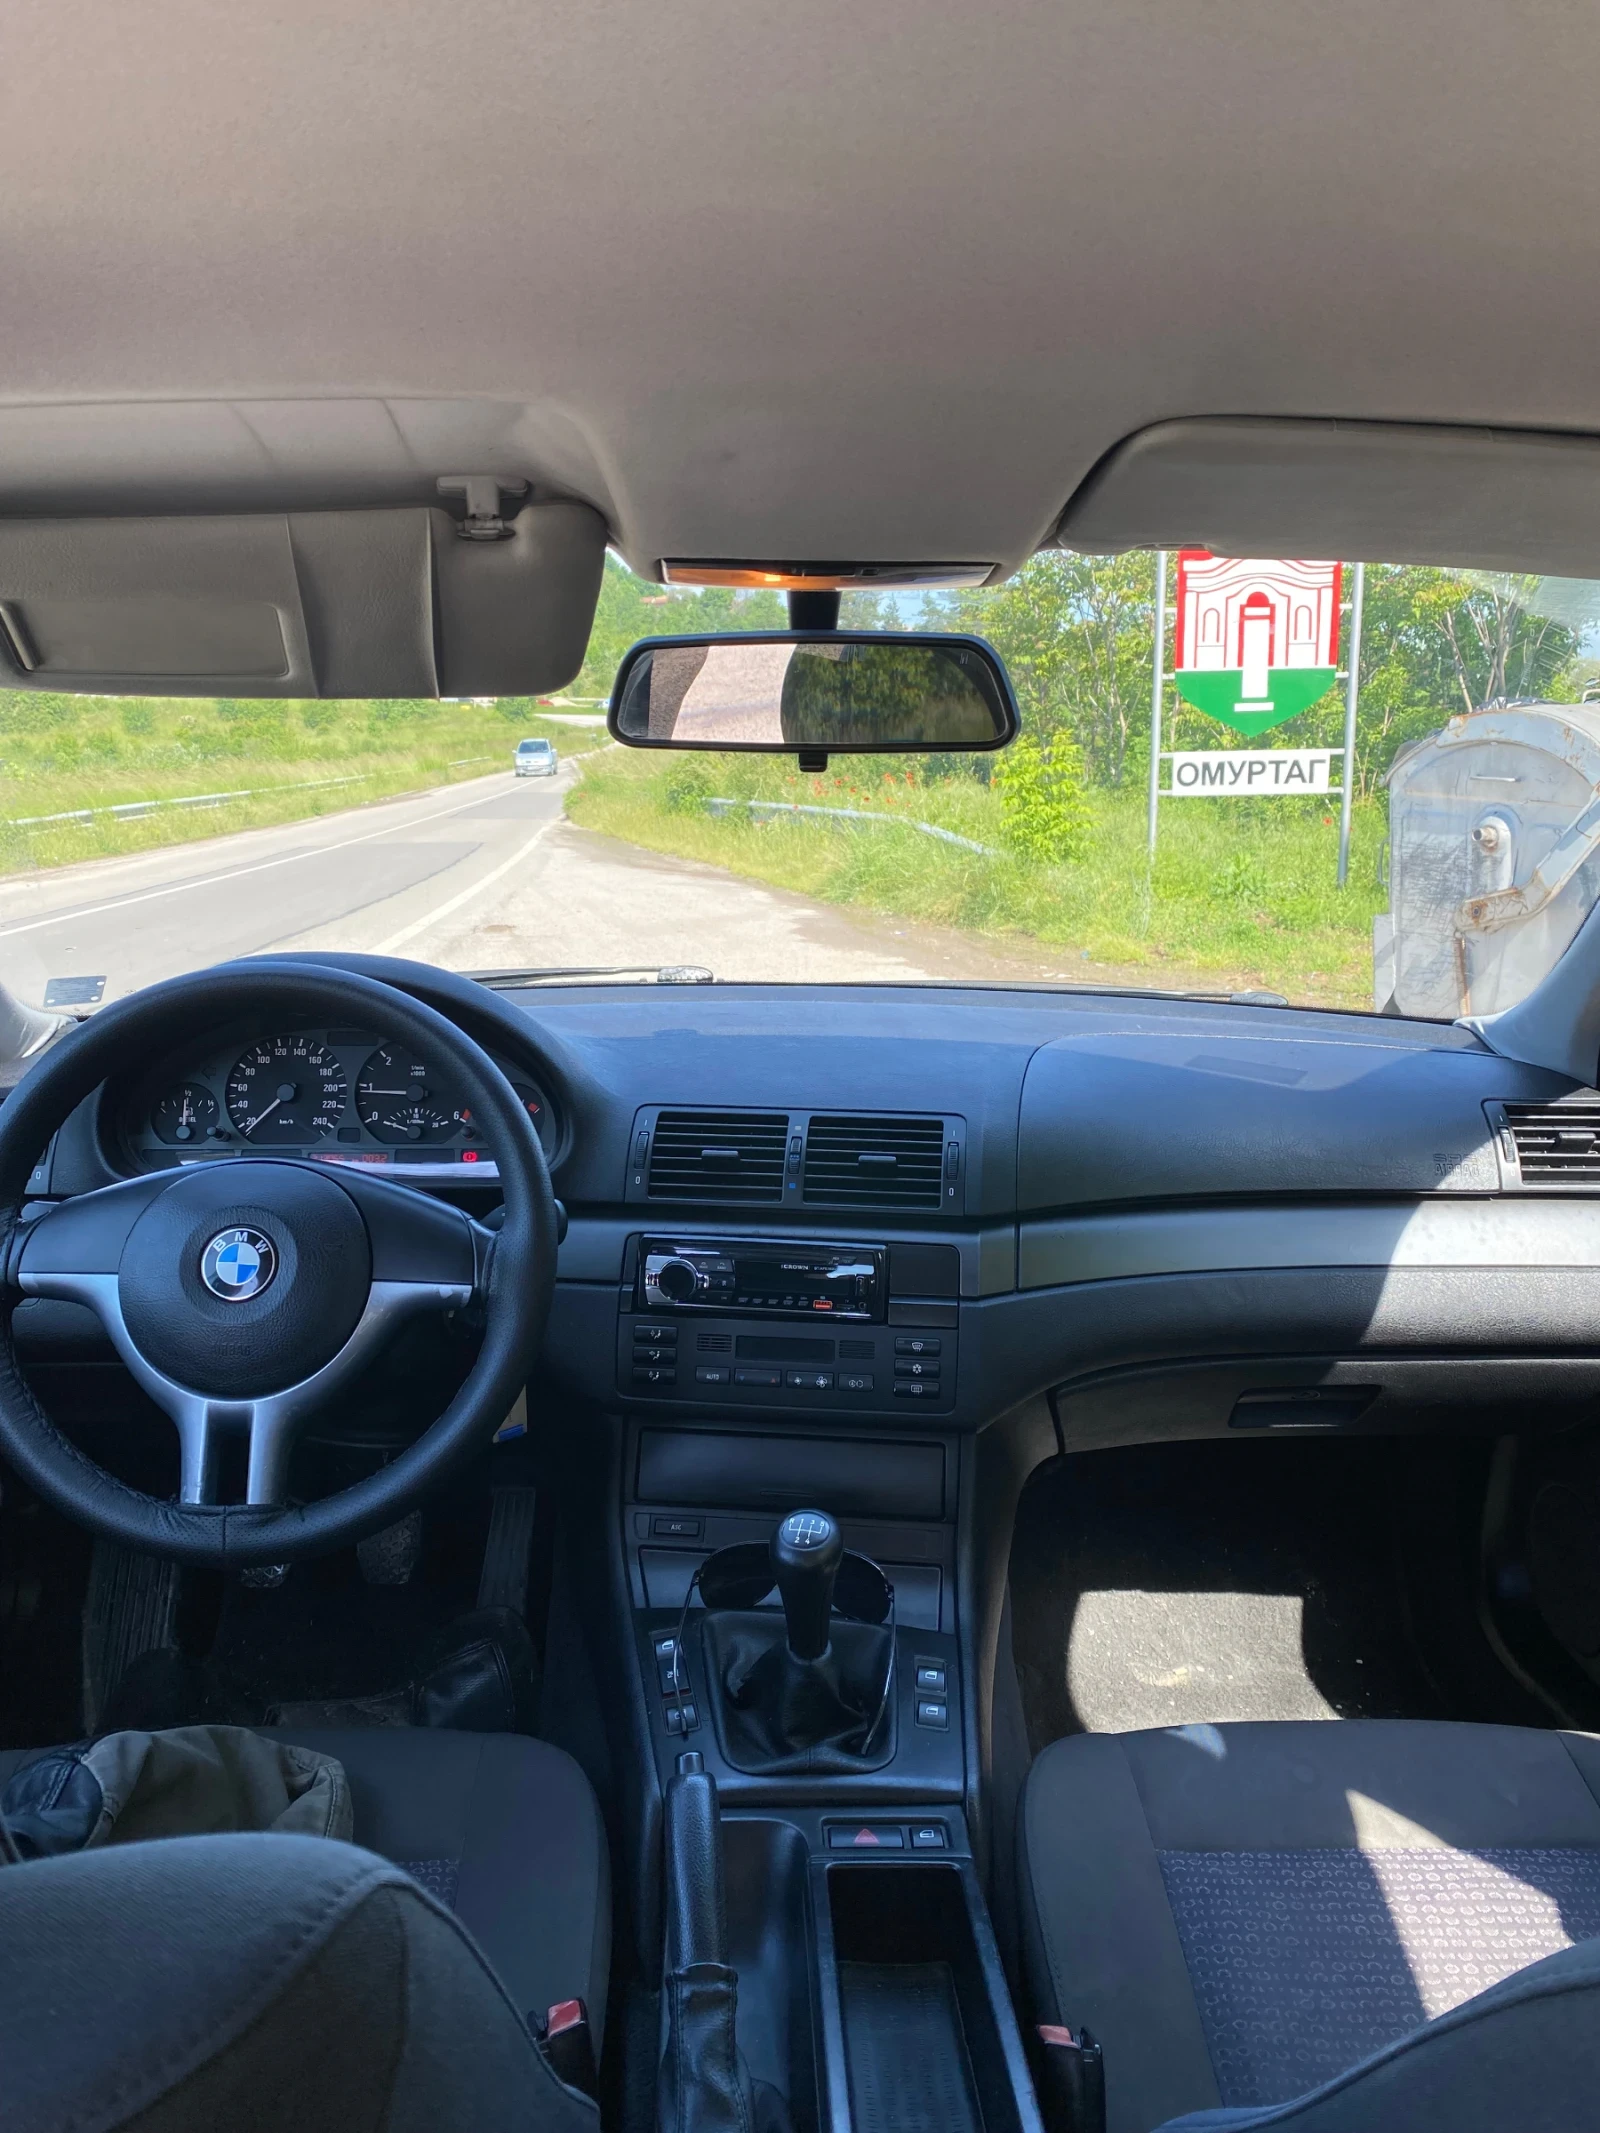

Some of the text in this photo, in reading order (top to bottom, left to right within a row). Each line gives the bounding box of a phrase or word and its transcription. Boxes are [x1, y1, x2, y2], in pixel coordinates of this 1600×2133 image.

[1176, 759, 1327, 787] ОМУРТАГ
[274, 1048, 287, 1056] 120
[293, 1048, 307, 1056] 140
[257, 1056, 270, 1064] 100
[309, 1056, 322, 1064] 160
[385, 1056, 392, 1066] 2
[245, 1067, 256, 1076] 80
[319, 1068, 333, 1076] 180
[237, 1083, 248, 1092] 60
[323, 1084, 338, 1092] 200
[237, 1100, 249, 1109] 40
[322, 1100, 337, 1109] 220
[371, 1111, 379, 1121] 0
[453, 1111, 460, 1120] 6
[312, 1117, 328, 1125] 240
[1434, 1163, 1480, 1177] AIRBAG
[212, 1231, 269, 1254] BMW
[706, 1373, 720, 1381] AUTO
